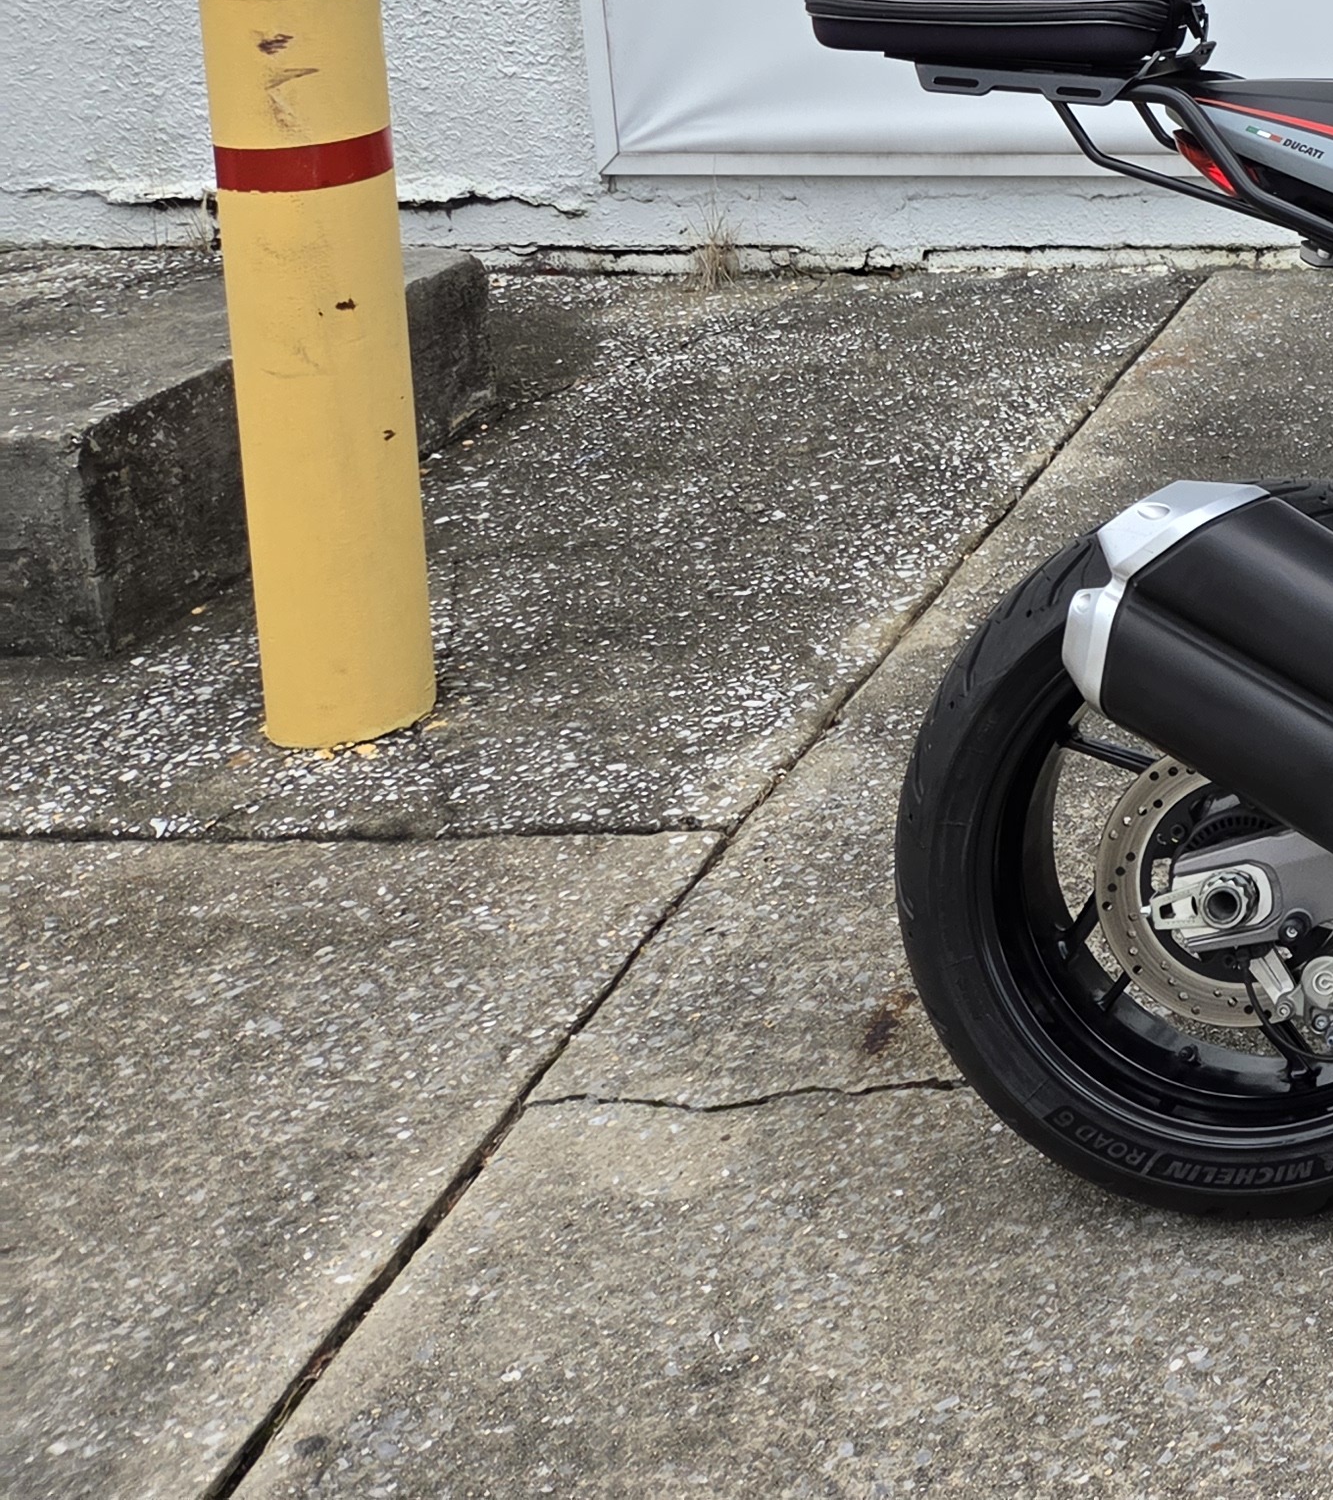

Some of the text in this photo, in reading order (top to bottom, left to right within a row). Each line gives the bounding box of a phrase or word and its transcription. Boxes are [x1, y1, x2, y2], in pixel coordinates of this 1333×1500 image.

[1282, 138, 1325, 159] DUCATI
[1053, 1110, 1315, 1187] MICHELIN ROAD 6
